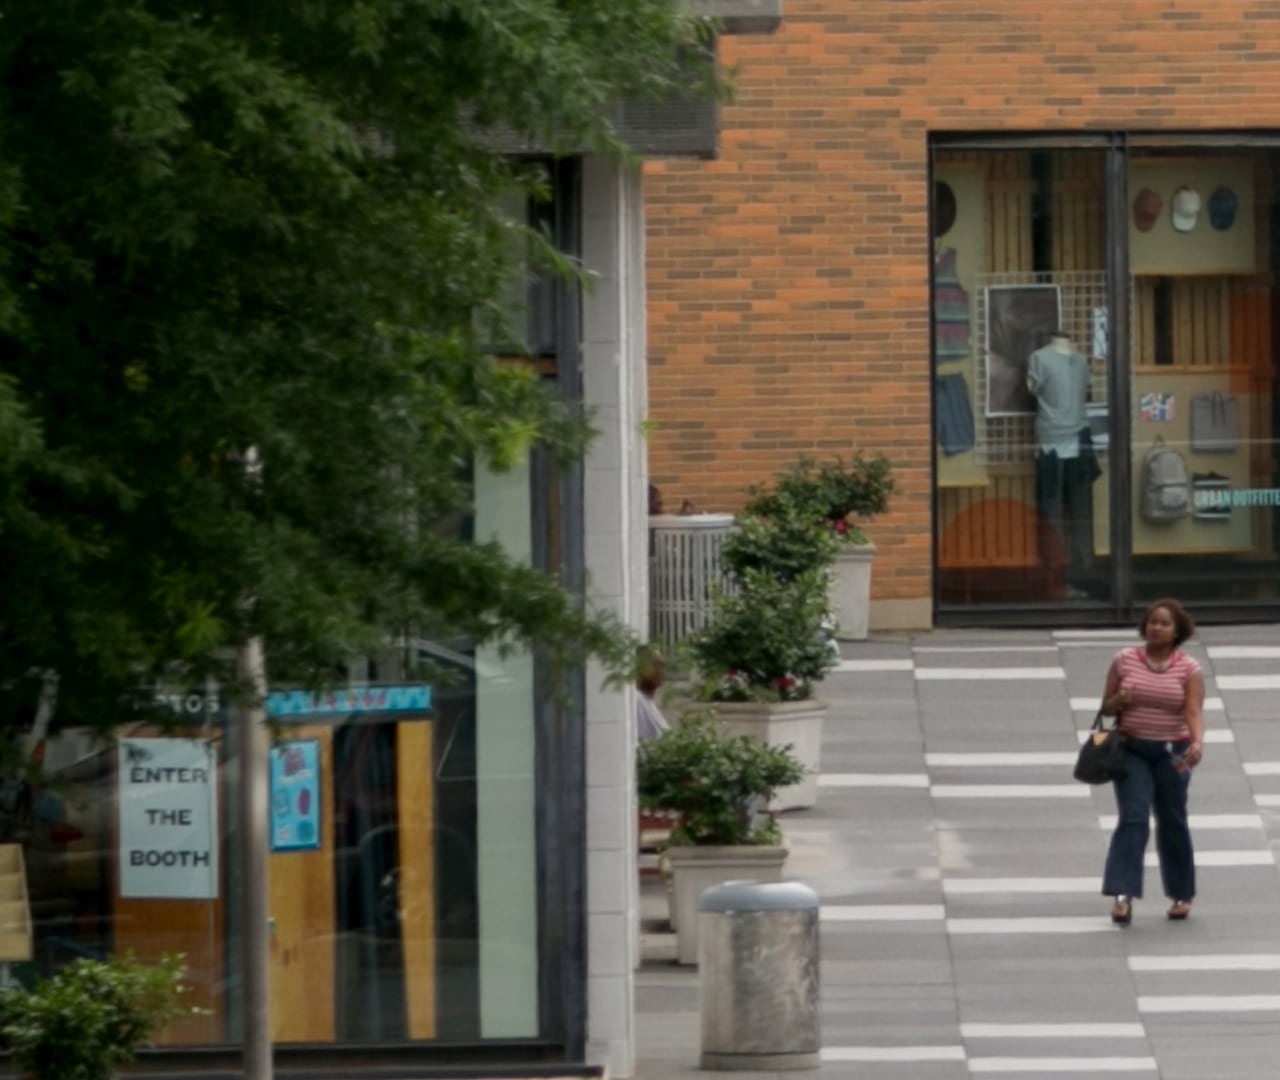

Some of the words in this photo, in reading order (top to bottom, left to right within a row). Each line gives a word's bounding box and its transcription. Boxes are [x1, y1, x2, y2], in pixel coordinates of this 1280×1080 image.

[1194, 490, 1231, 508] URBAN
[130, 767, 208, 784] ENTER
[145, 809, 192, 826] THE
[130, 850, 210, 867] BOOTH
